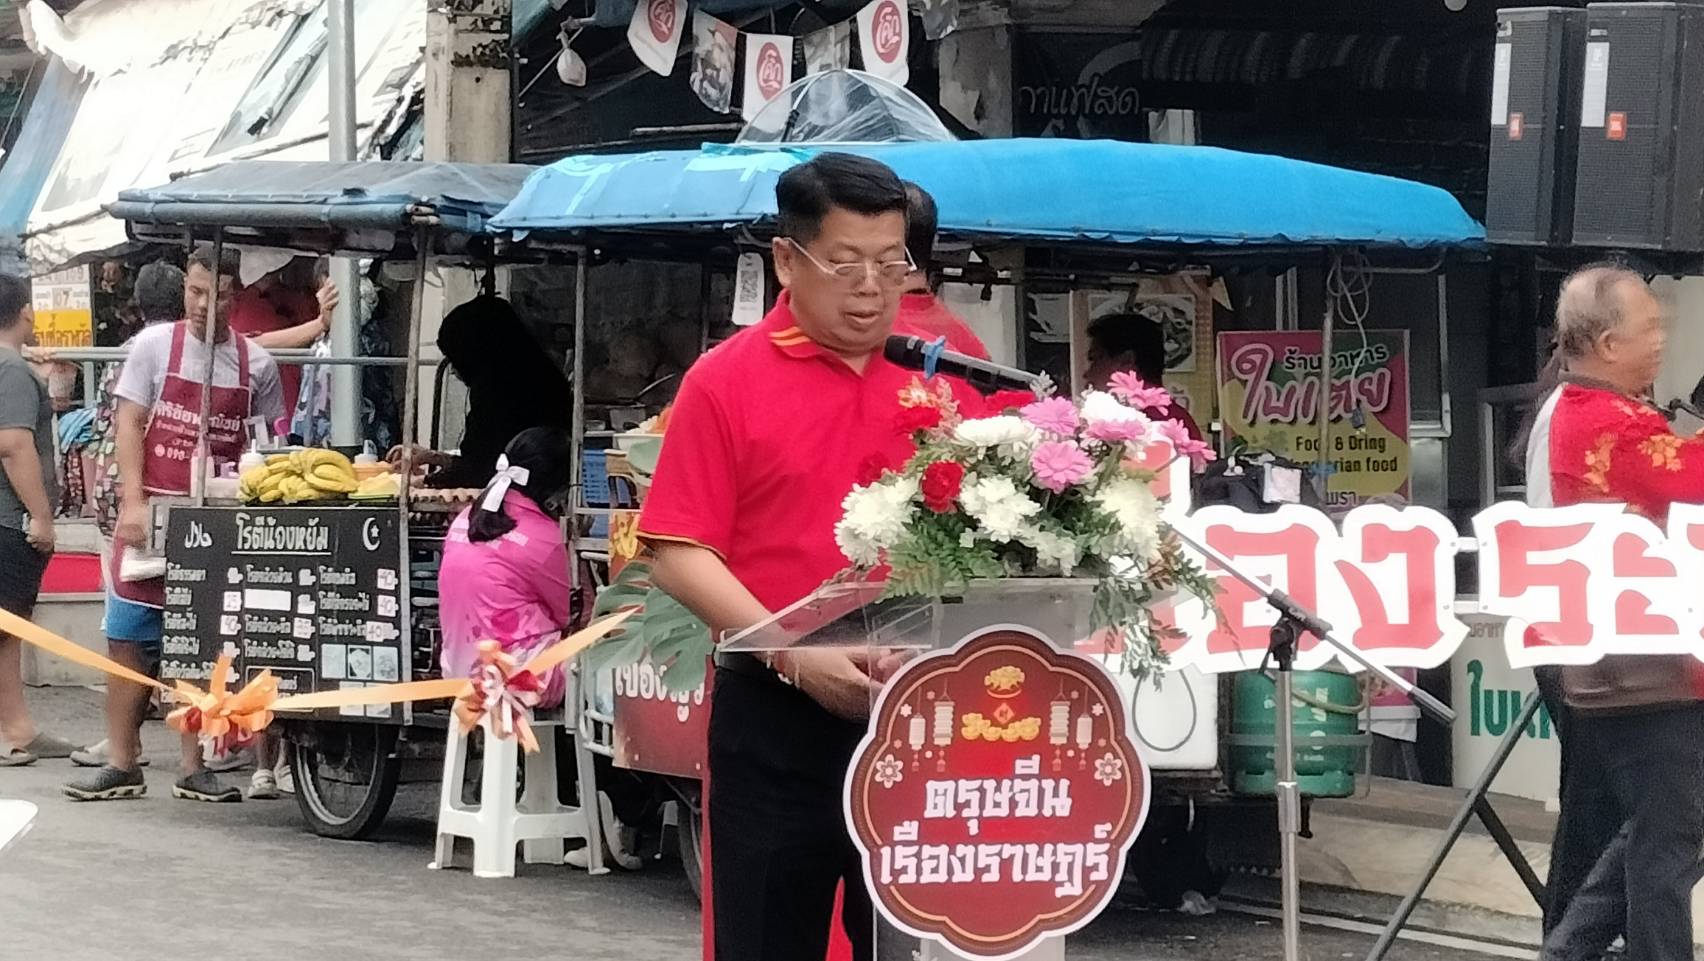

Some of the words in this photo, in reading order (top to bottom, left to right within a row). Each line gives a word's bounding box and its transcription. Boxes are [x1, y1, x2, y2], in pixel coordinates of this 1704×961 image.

[1349, 436, 1386, 453] Dring
[1366, 456, 1398, 472] food
[368, 624, 382, 638] 40
[924, 754, 1073, 835] ตรุษจีน
